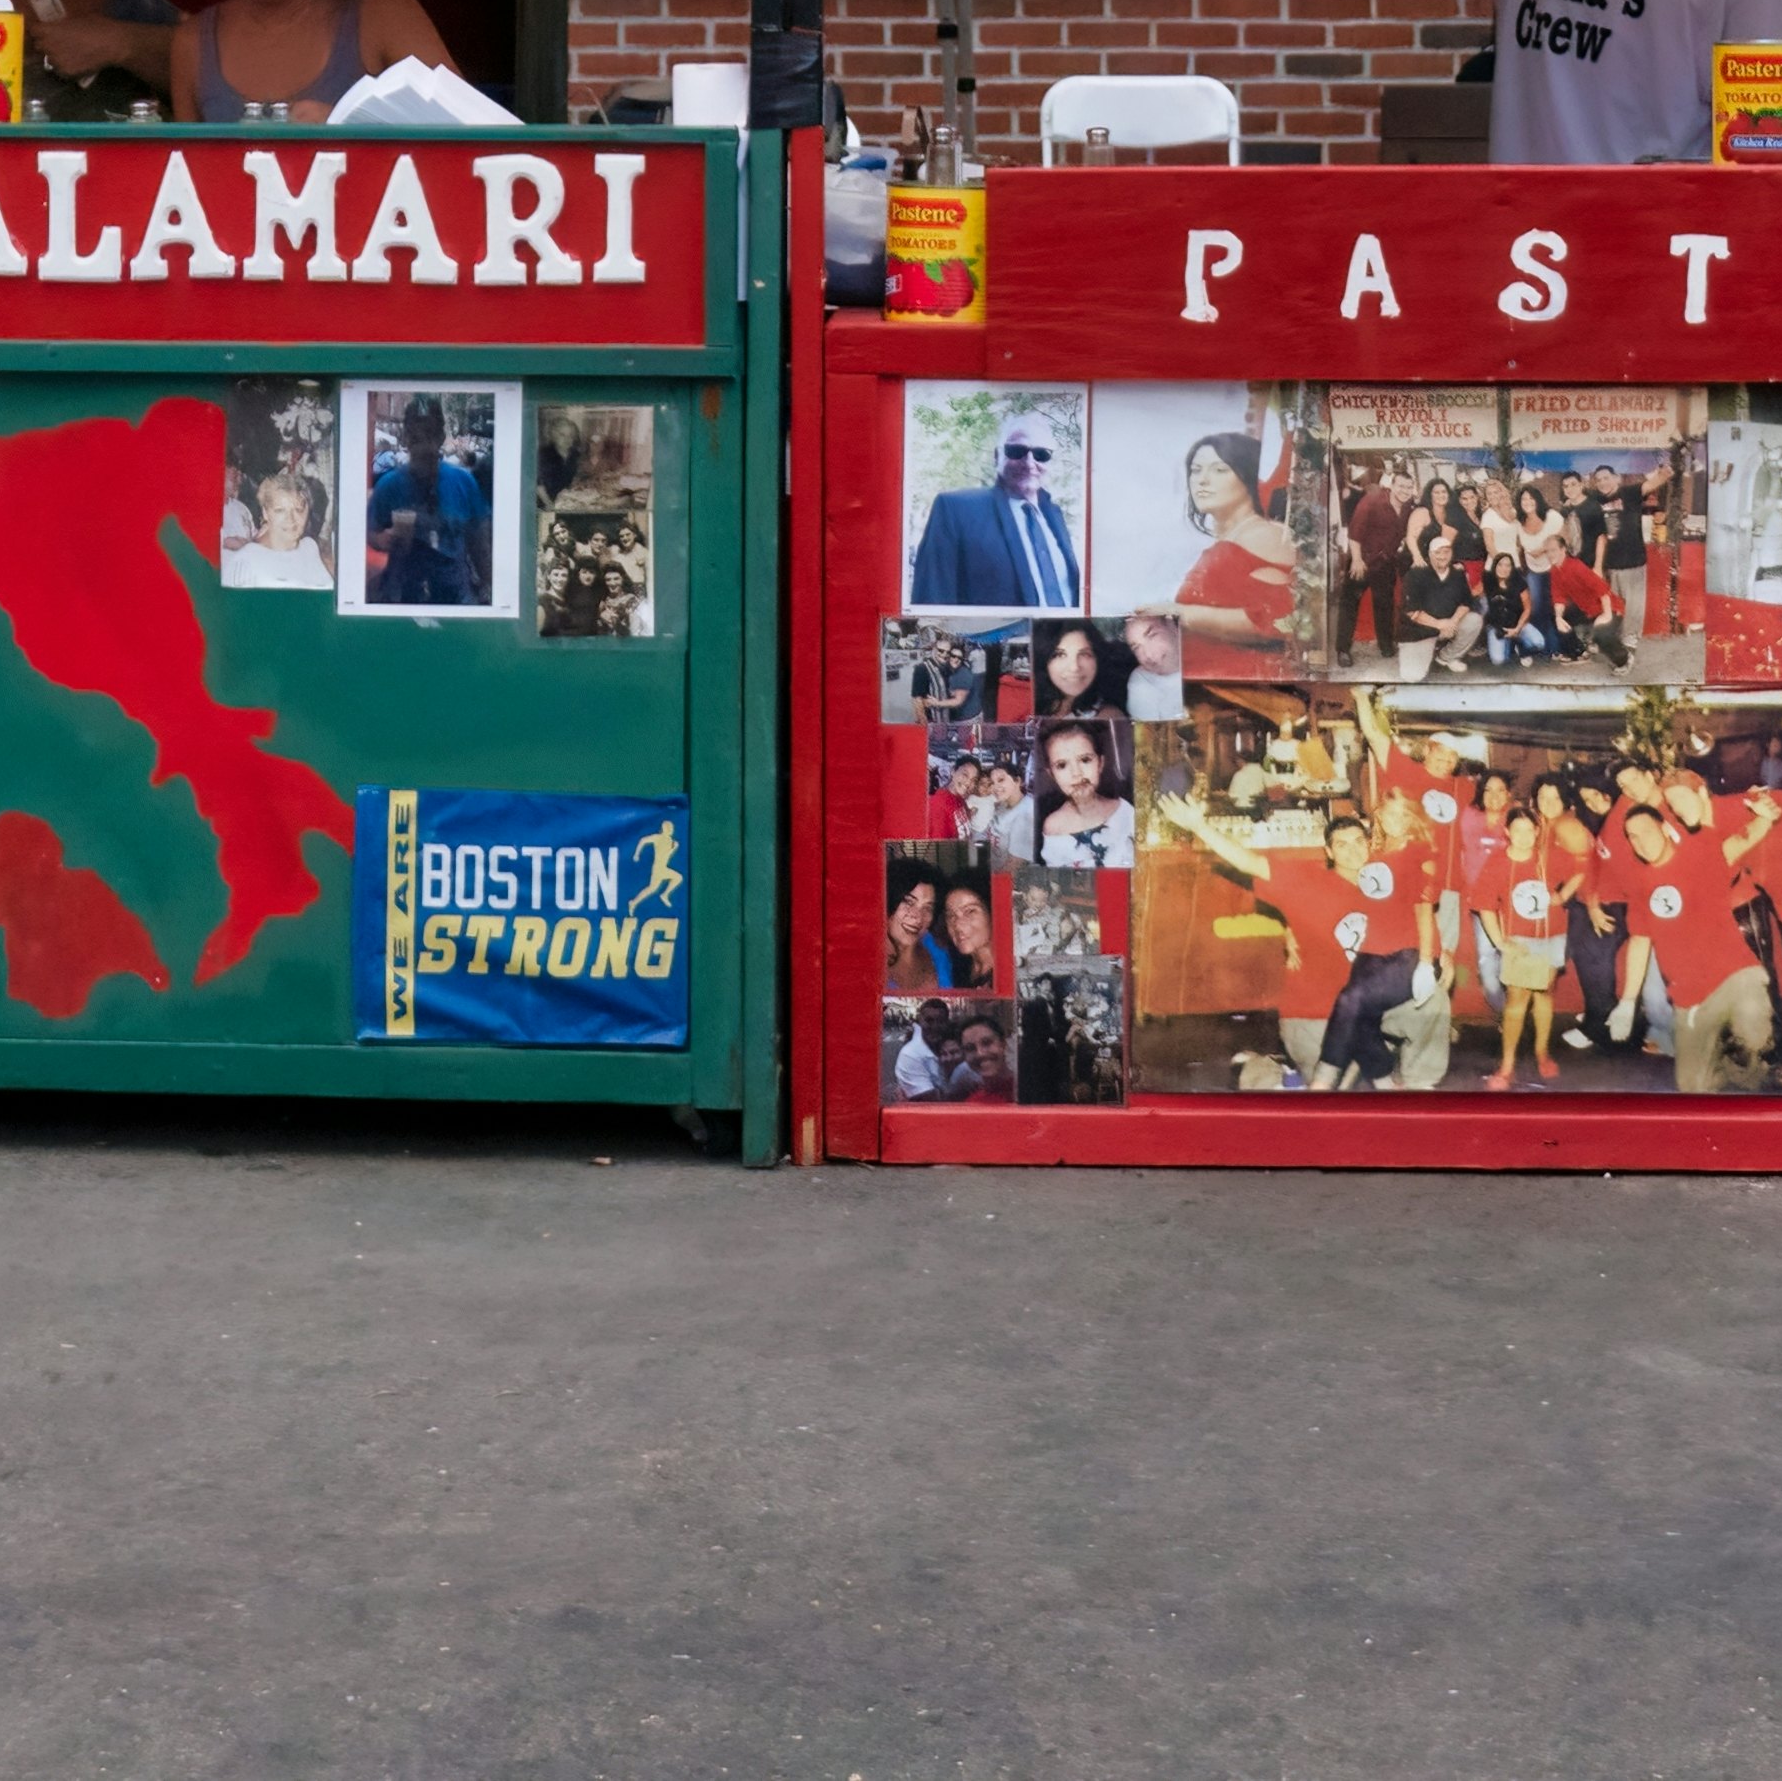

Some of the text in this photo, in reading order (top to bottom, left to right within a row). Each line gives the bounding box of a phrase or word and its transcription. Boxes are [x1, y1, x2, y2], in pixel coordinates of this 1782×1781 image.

[1733, 137, 1765, 147] Kitchen
[892, 203, 958, 223] Pastene
[890, 236, 957, 250] TOMATOES
[1513, 394, 1571, 412] FRIED
[1375, 408, 1448, 423] RAVIOLI
[1421, 423, 1473, 437] SAUCE
[1541, 417, 1667, 434] FRIED SHRIMP
[422, 843, 619, 910] BOSTON
[392, 804, 410, 1020] WE ARE
[417, 915, 679, 979] STRONG
